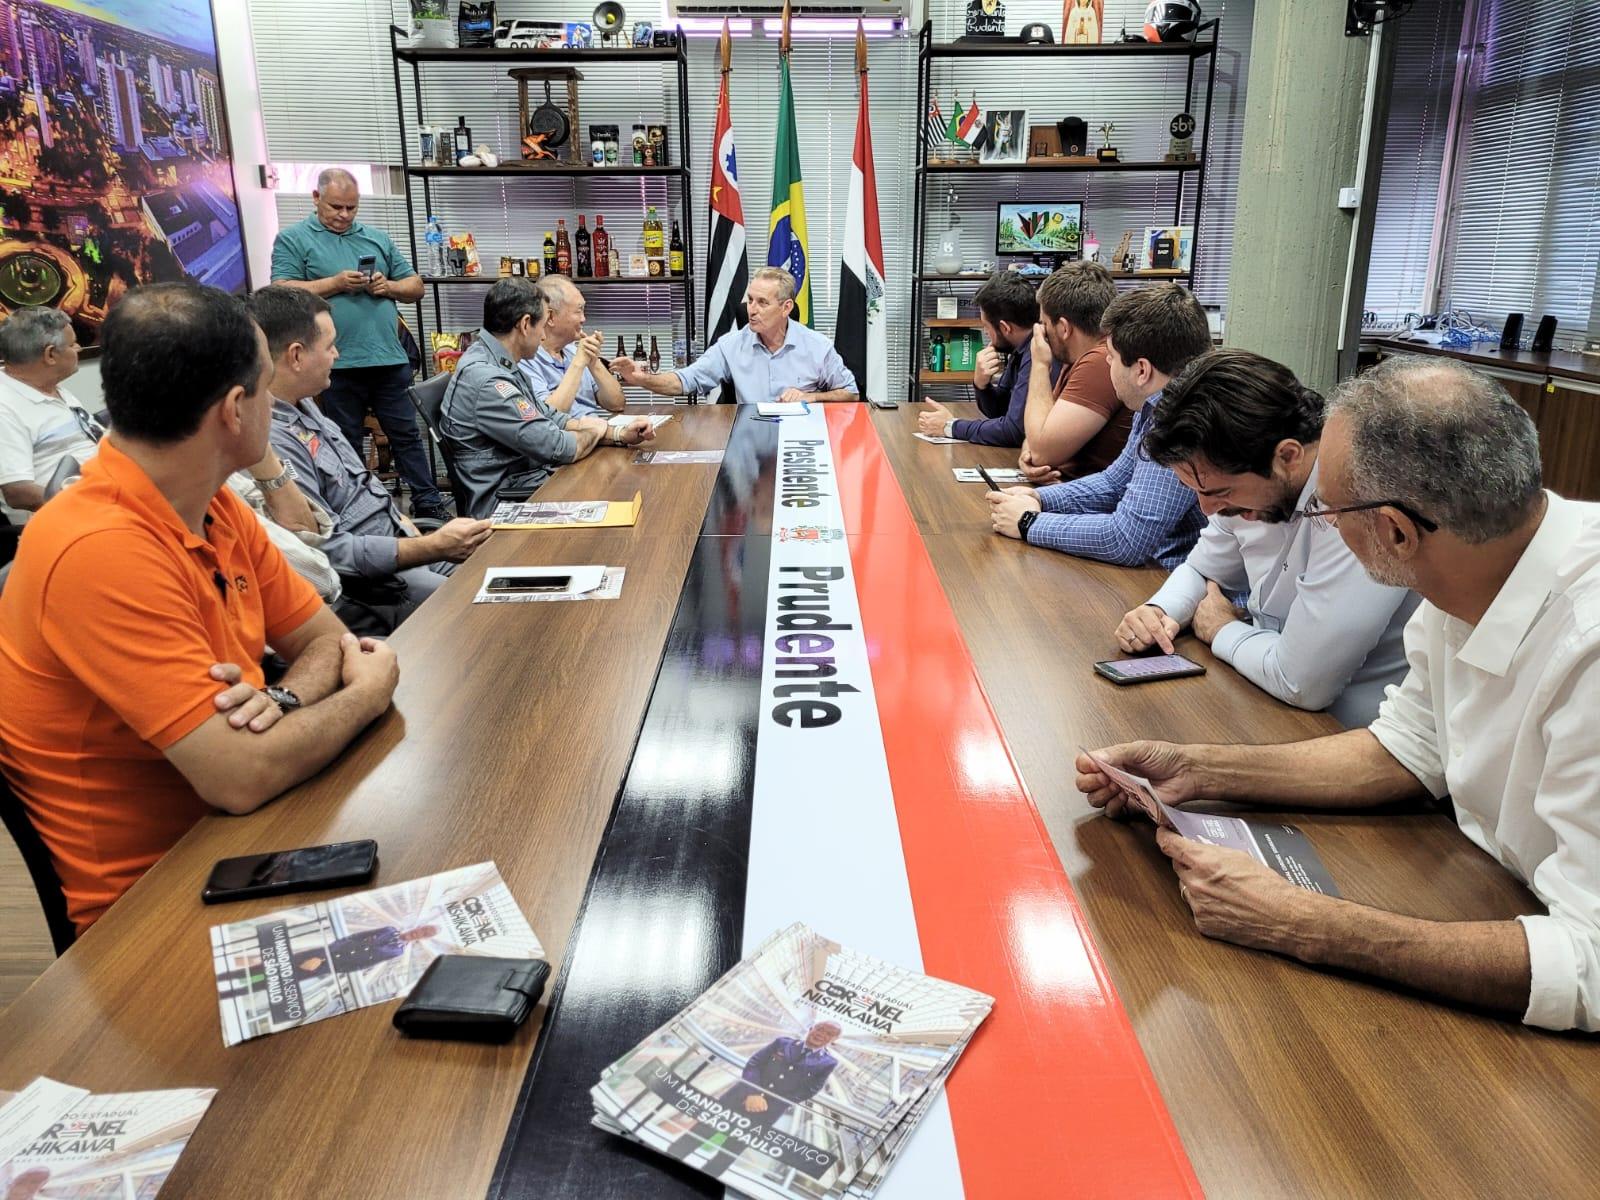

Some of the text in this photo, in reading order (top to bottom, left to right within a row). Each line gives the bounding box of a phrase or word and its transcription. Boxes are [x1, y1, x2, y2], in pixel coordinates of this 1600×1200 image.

[1171, 117, 1194, 132] sbt
[780, 439, 832, 508] Presidente
[771, 566, 861, 729] Prudente
[272, 925, 285, 940] UM
[262, 947, 283, 1004] DE SÃO PAULO
[274, 939, 294, 978] MANDATO
[284, 983, 302, 1019] SERVIÇO
[801, 988, 893, 1034] NISHIKAWA
[824, 971, 914, 1010] DEPUTADO ESTADUAL
[655, 1067, 830, 1166] UM MANDATO A SERVIÇO
[675, 1099, 783, 1158] DE SÃO PAULO
